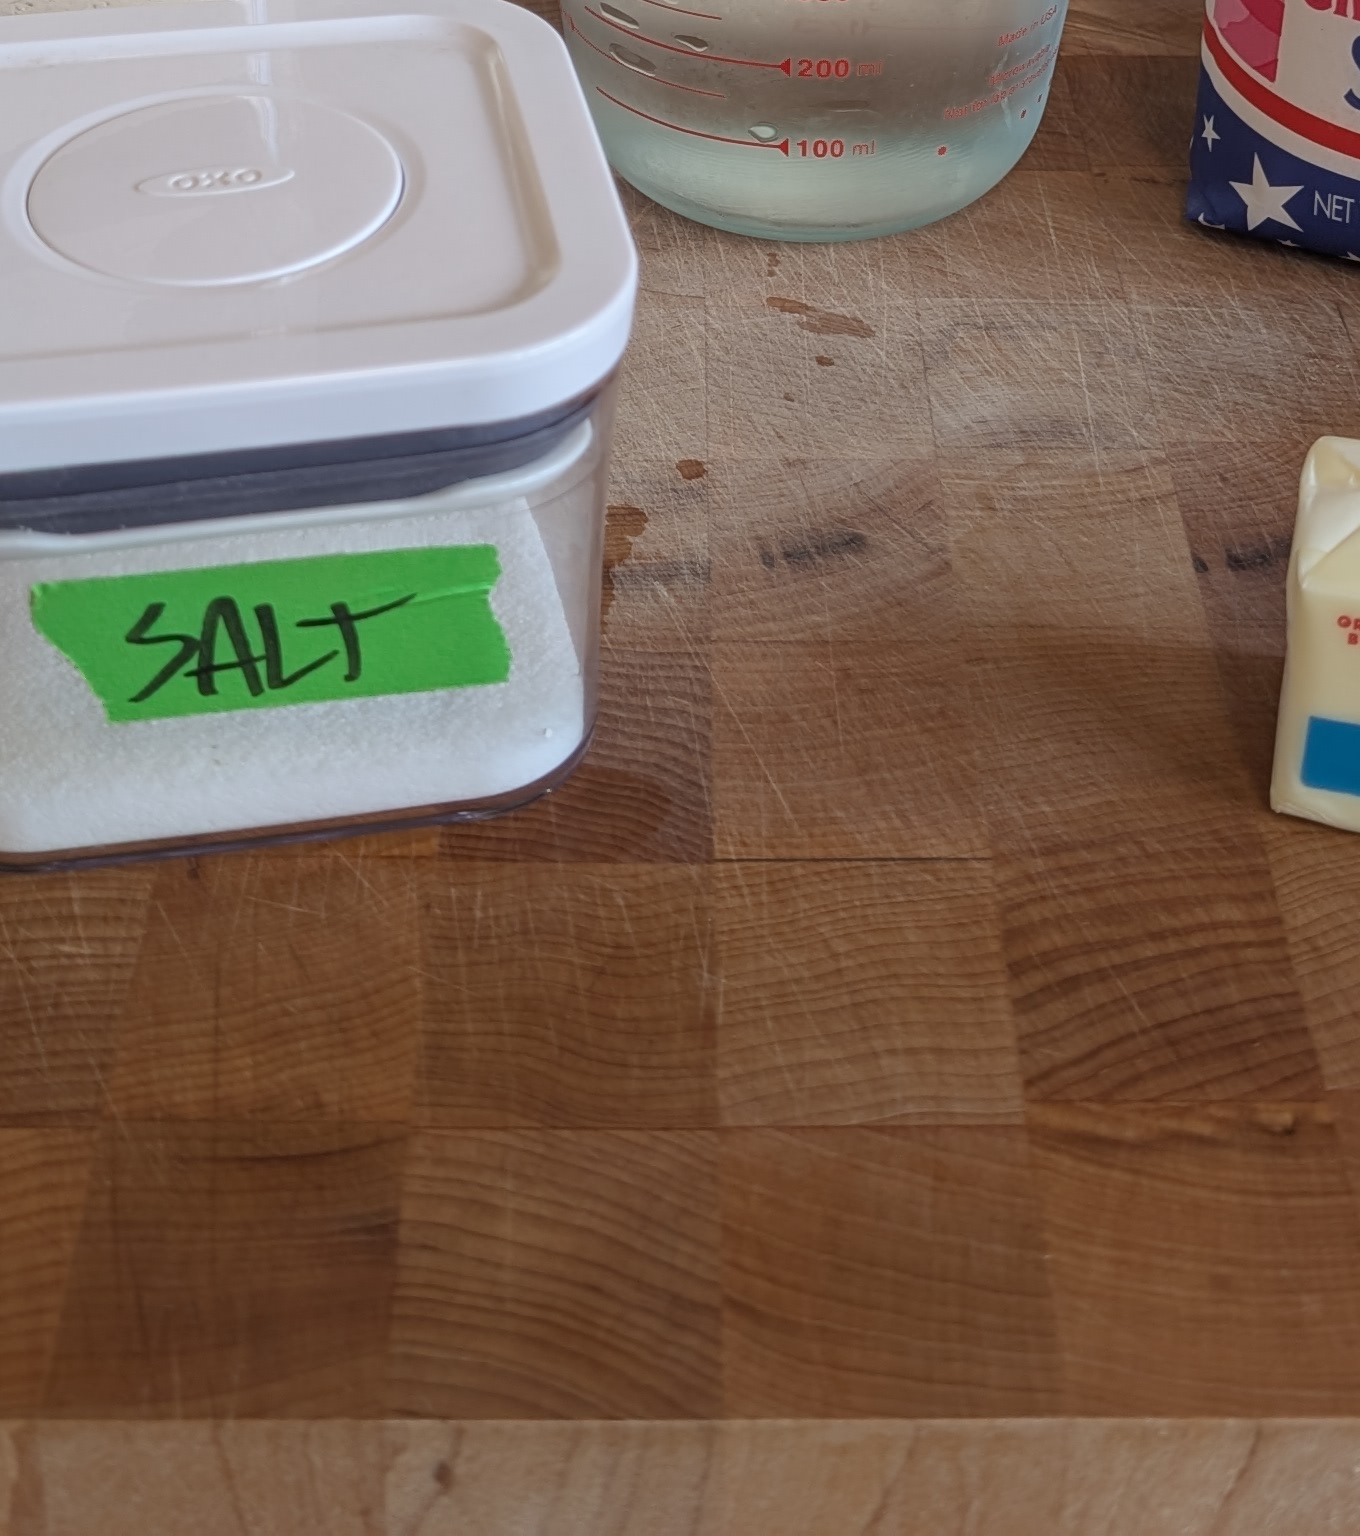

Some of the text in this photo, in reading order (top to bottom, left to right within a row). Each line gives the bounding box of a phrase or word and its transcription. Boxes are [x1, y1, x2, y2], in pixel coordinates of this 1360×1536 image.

[797, 59, 849, 78] 200
[796, 139, 875, 158] 100 ml
[1313, 190, 1354, 224] NET
[125, 591, 418, 703] SALT
